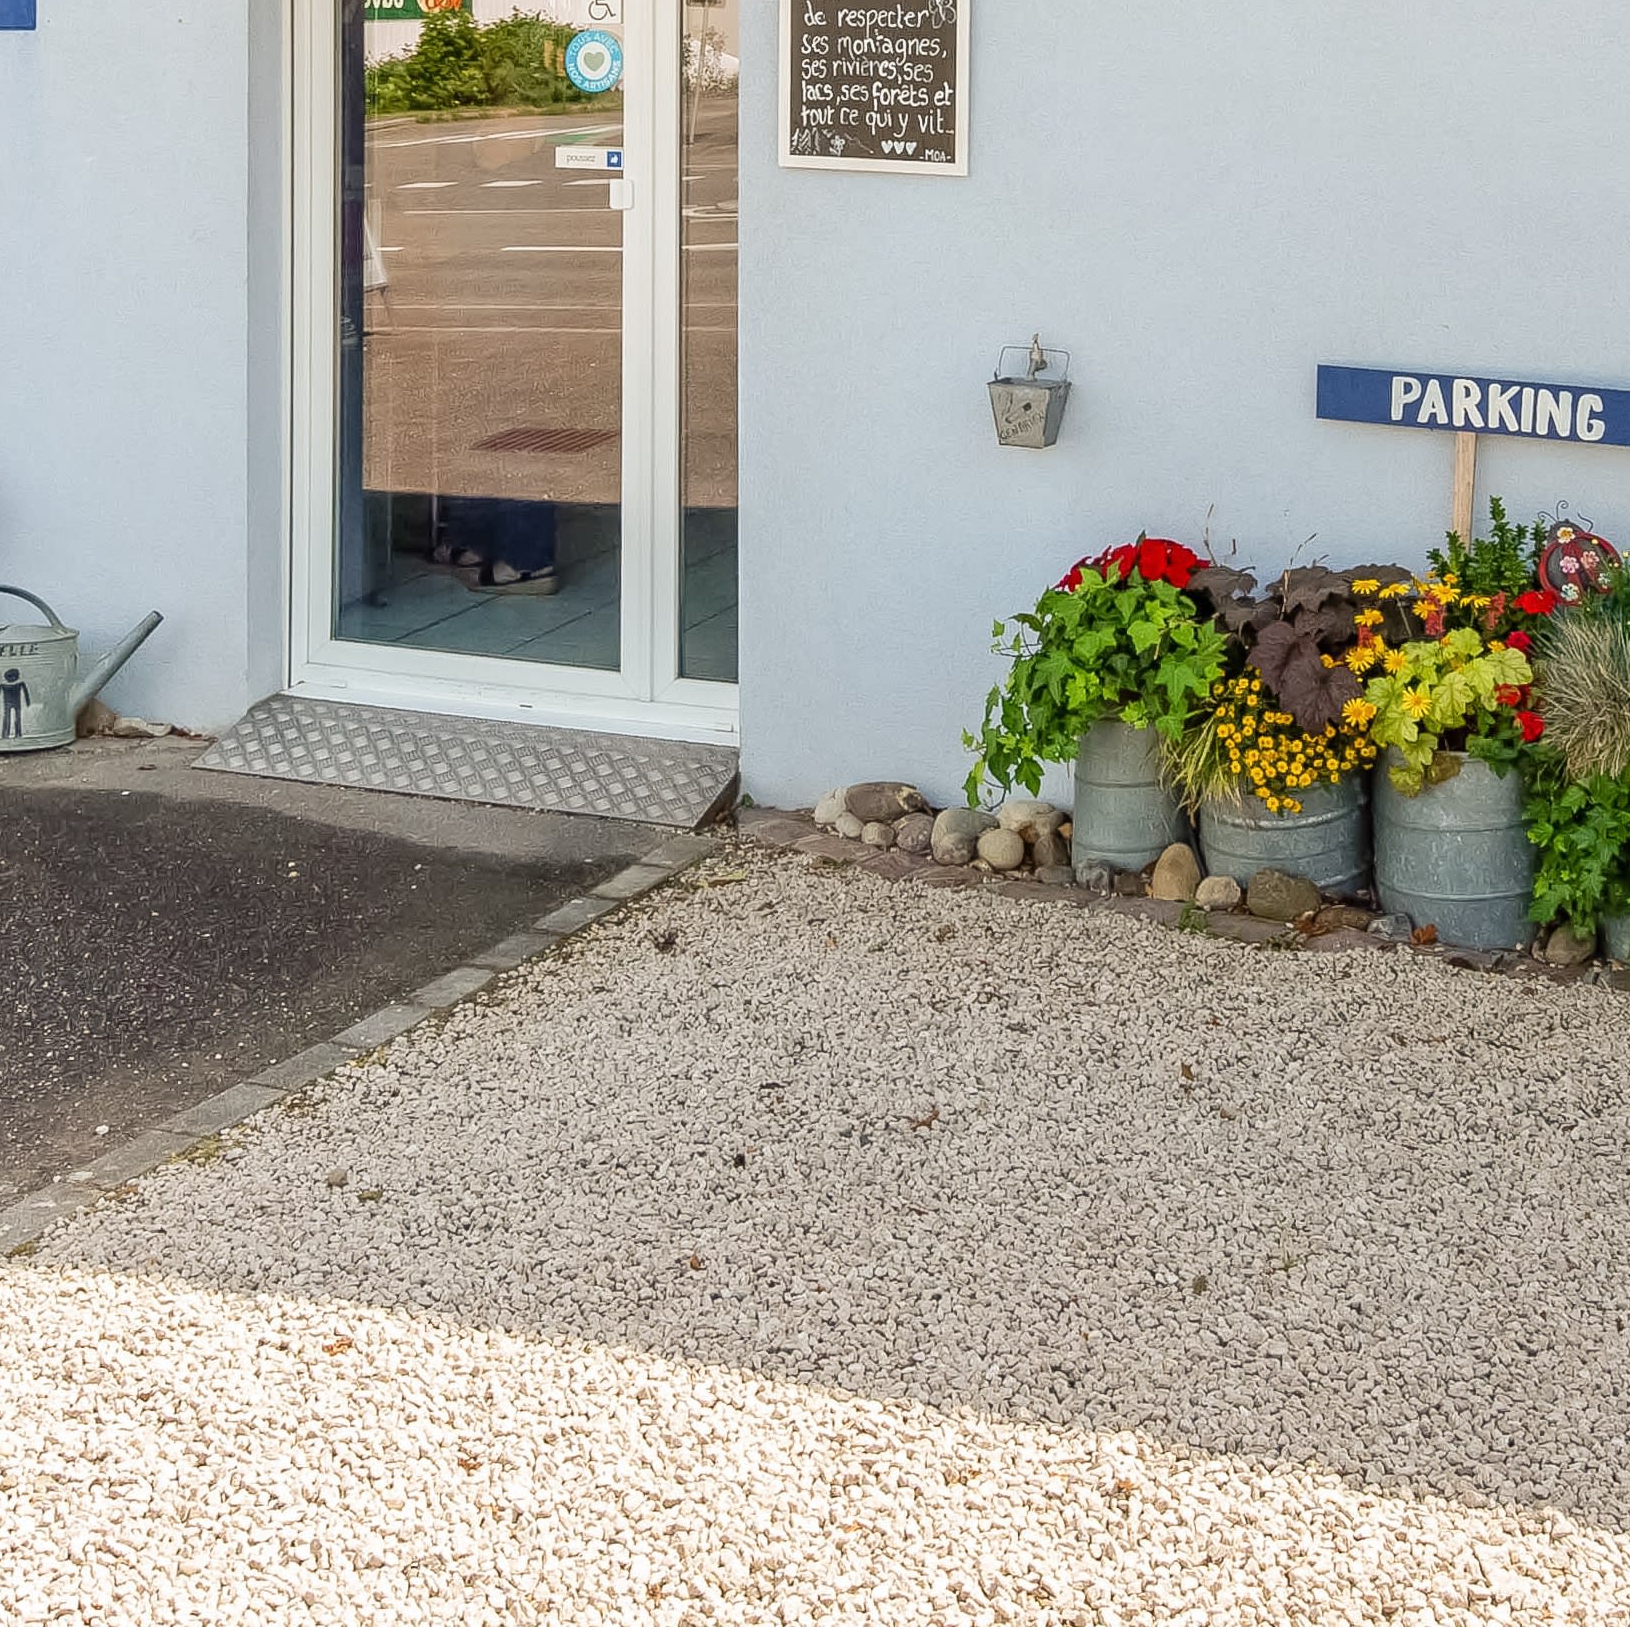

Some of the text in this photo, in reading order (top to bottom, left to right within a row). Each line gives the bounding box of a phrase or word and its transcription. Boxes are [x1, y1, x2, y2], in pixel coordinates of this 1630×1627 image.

[804, 0, 929, 37] de respecter
[801, 34, 829, 55] ses
[802, 59, 827, 79] ses
[872, 82, 929, 111] forêts
[934, 82, 953, 106] et
[801, 105, 835, 126] tout
[840, 108, 859, 124] ce
[866, 110, 892, 135] qui
[894, 113, 908, 137] y
[1389, 376, 1606, 442] PARKING
